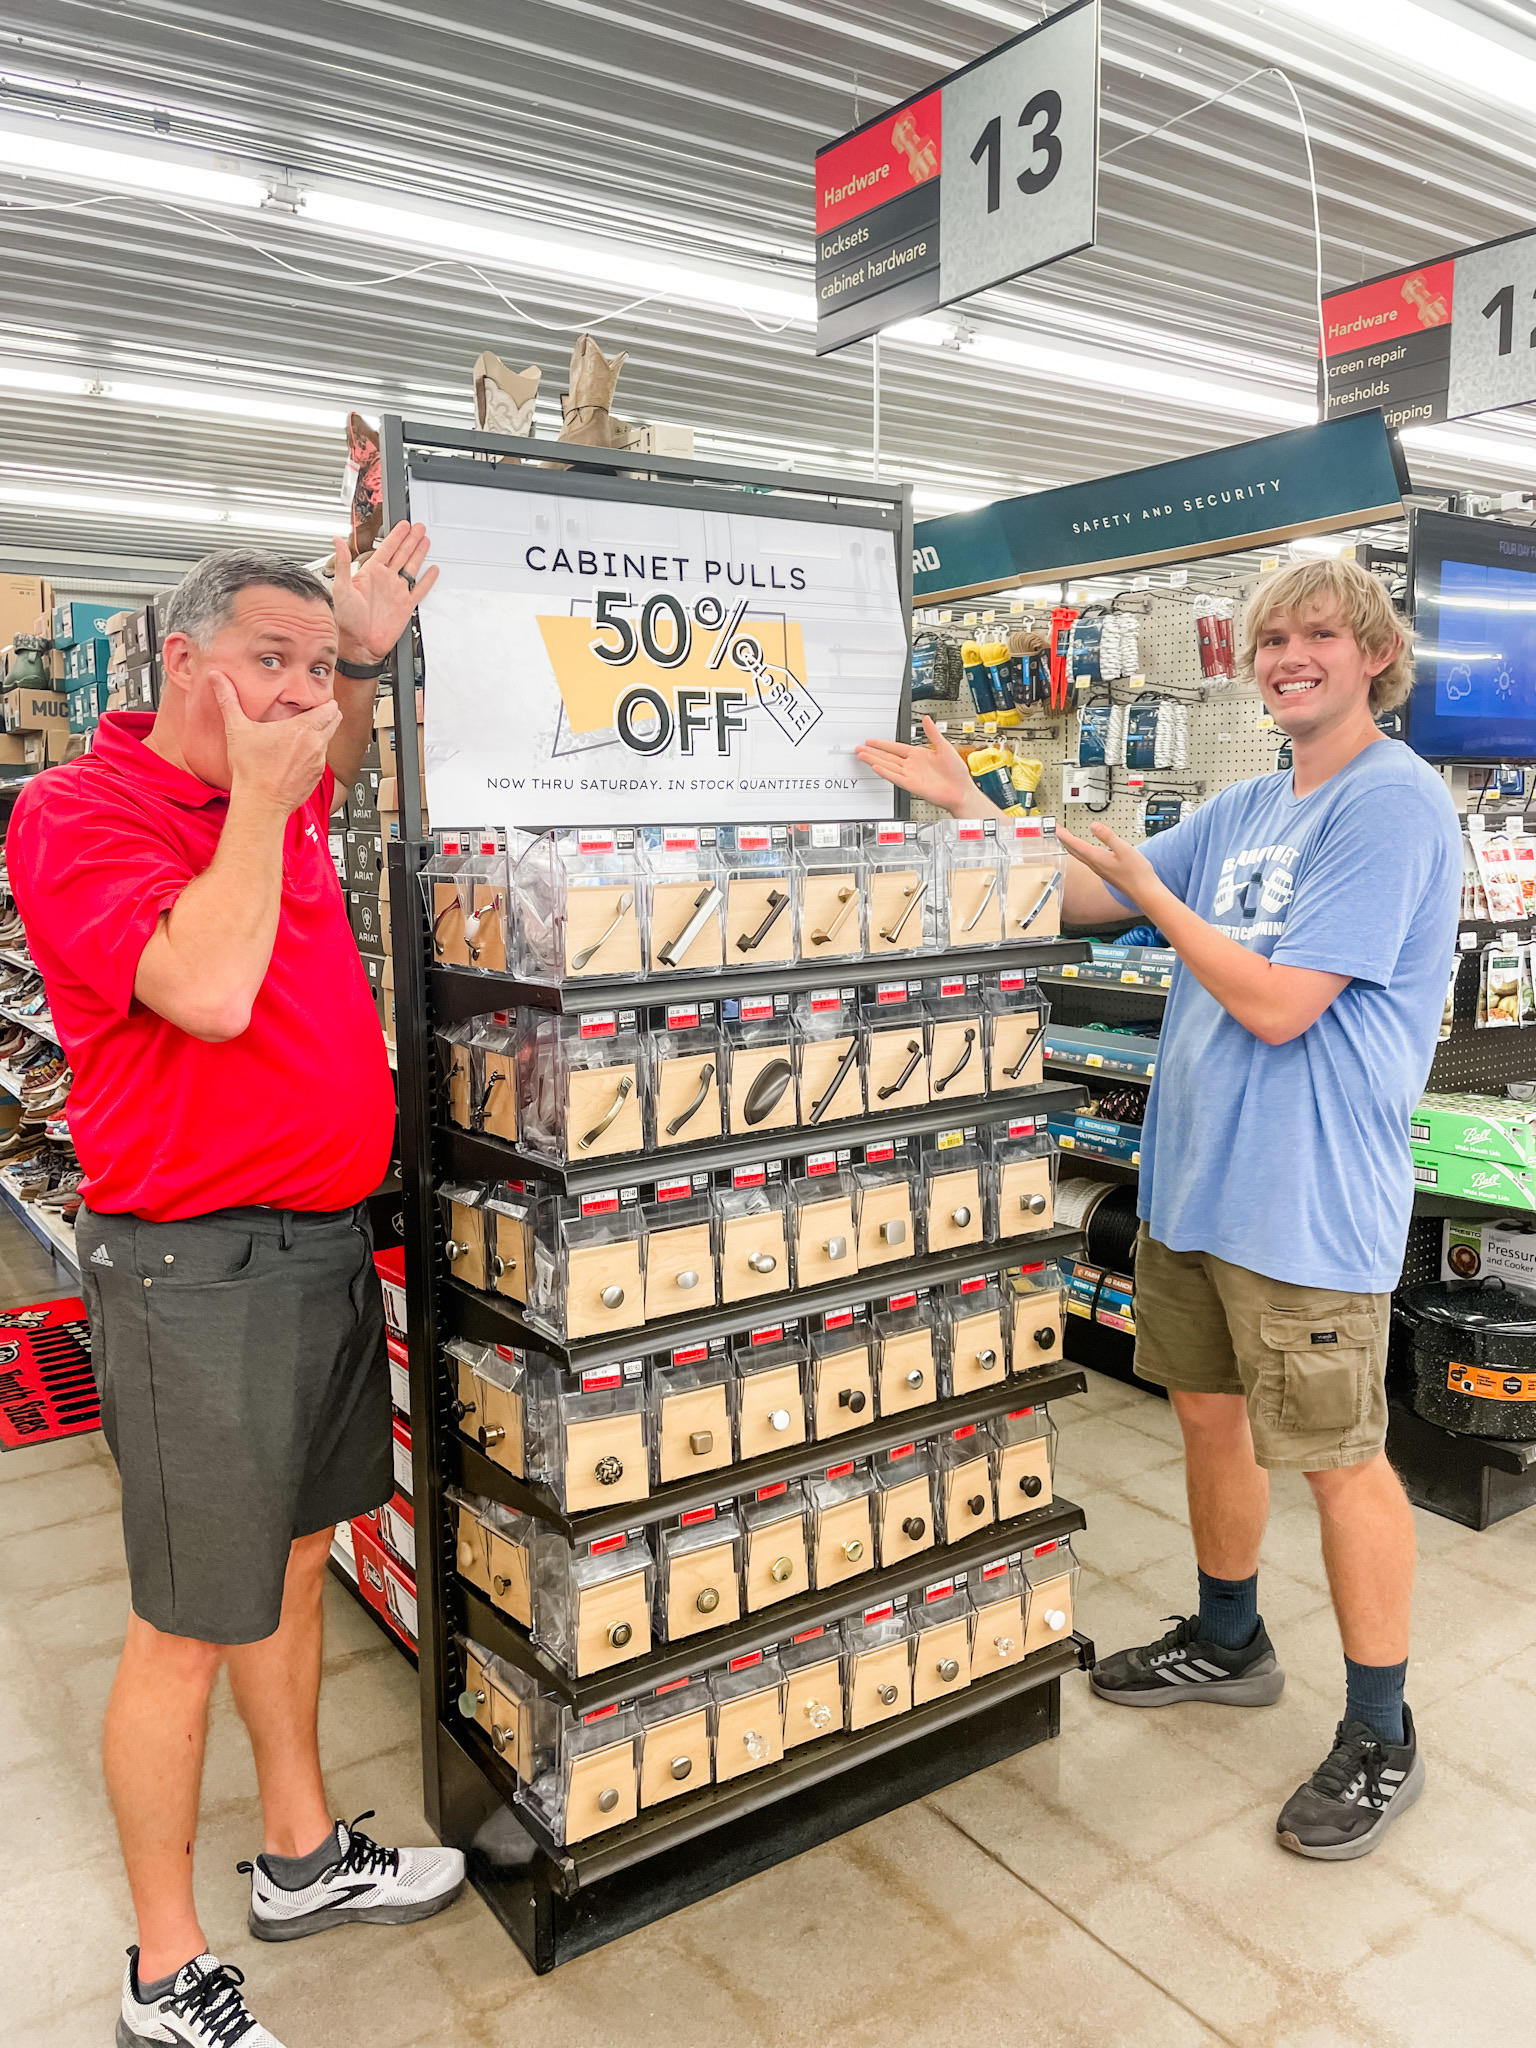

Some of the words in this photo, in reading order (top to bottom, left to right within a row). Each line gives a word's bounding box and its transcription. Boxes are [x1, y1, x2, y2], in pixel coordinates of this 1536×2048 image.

[969, 89, 1062, 214] 13
[824, 163, 890, 209] Hardware
[821, 227, 869, 261] locksets
[821, 268, 864, 300] cabinet
[867, 242, 927, 280] hardware
[1328, 308, 1398, 339] Hardware
[1481, 285, 1536, 357] 1
[1367, 346, 1407, 369] repair
[1323, 380, 1390, 408] hresholds
[1072, 512, 1133, 534] SAFETY
[1142, 505, 1174, 521] AND
[1183, 478, 1283, 512] SECURITY
[524, 545, 690, 583] CABINET
[705, 560, 807, 591] PULLS
[912, 545, 941, 574] RD
[589, 586, 762, 672] 50%
[32, 699, 68, 718] MUC
[612, 682, 748, 757] OFF
[487, 778, 526, 789] NOW
[532, 778, 574, 790] THRU
[580, 779, 662, 790] SATURDAY.
[667, 779, 685, 790] IN
[690, 779, 734, 790] STOCK
[739, 779, 820, 791] QUANTITIES
[824, 779, 858, 789] ONLY
[353, 809, 372, 819] ARIAT
[354, 871, 374, 882] ARIAT
[358, 932, 379, 944] ARIAT
[1076, 1131, 1117, 1146] POLYPROPYLENE
[1084, 1121, 1116, 1133] RECREATION
[1463, 1127, 1494, 1146] Ball
[1471, 1171, 1502, 1190] Ball
[1486, 1256, 1503, 1266] and
[1504, 1259, 1534, 1273] Cooker
[1487, 1242, 1536, 1263] Pressur
[3, 1400, 49, 1435] Sizes
